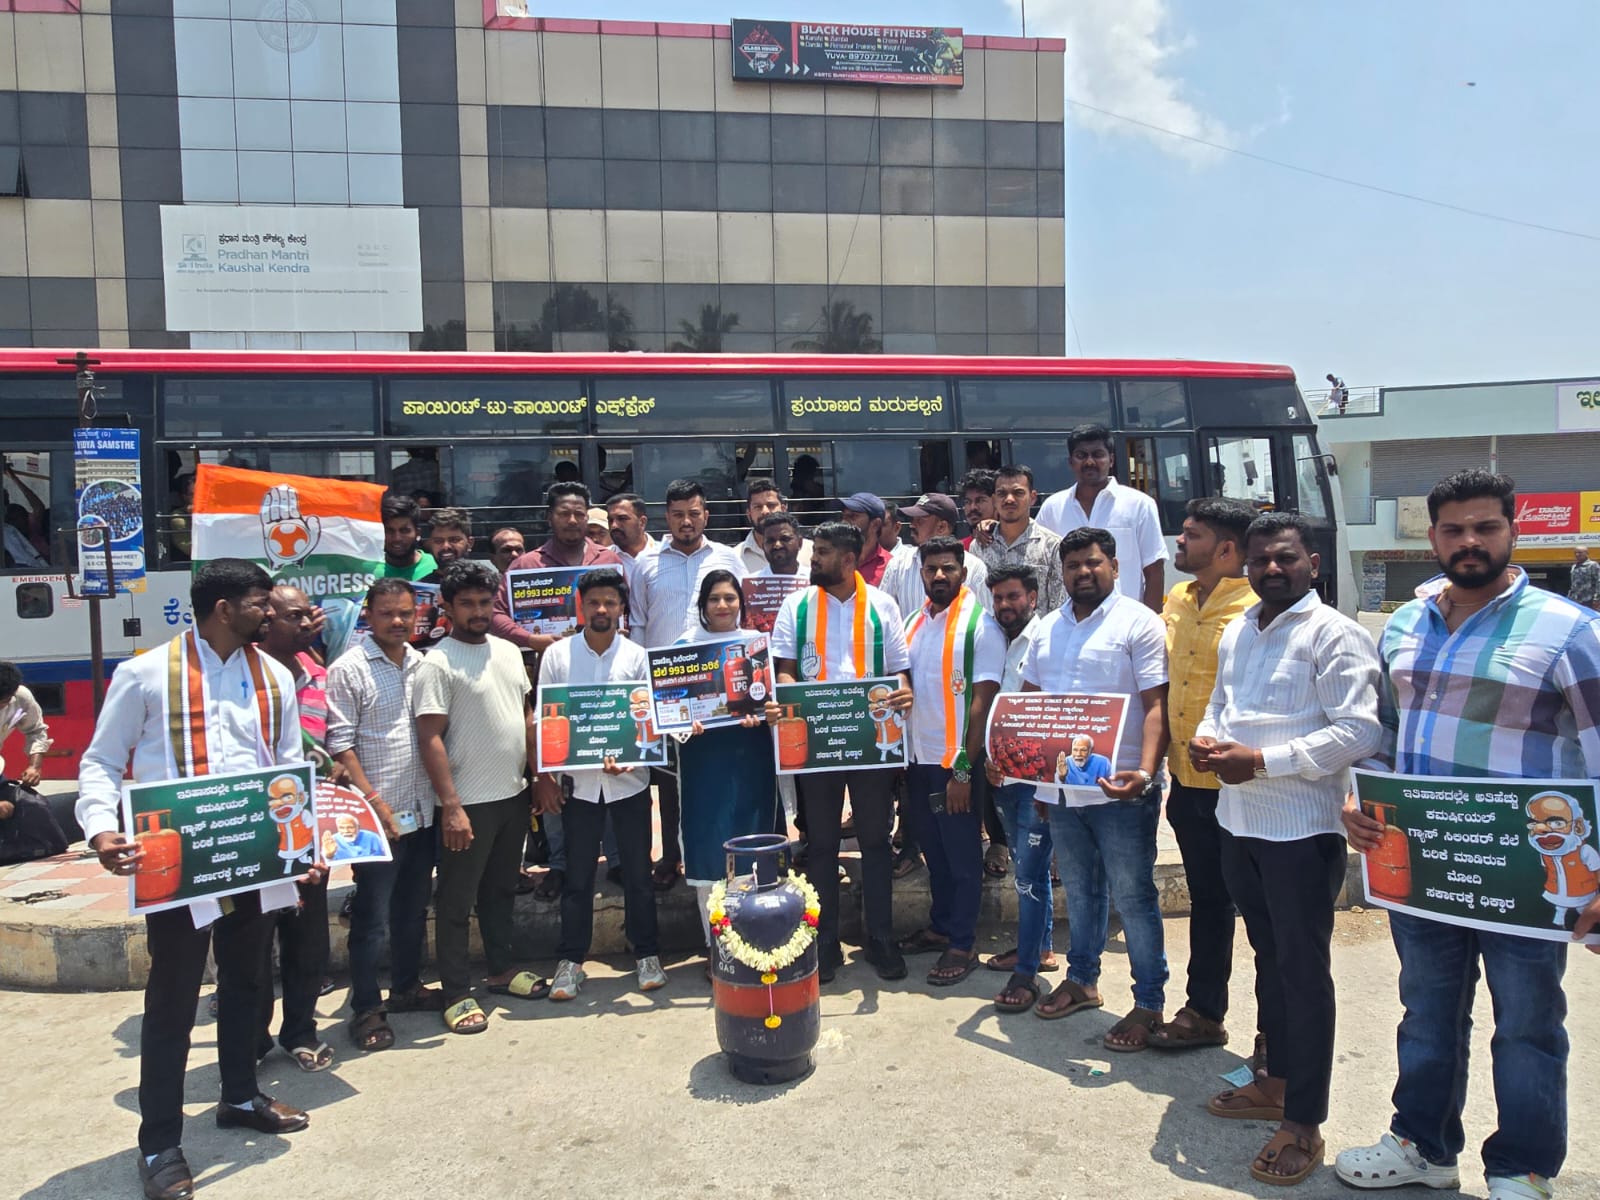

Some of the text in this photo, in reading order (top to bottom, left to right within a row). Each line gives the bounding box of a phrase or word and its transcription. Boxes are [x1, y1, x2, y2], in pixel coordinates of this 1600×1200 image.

[802, 26, 926, 38] BLACK HOUSE FITNESS
[218, 234, 307, 248] ಪ್ರಧಾನ ಮಂತ್ರಿ ಕೌಶಲ್ಯ ಕೇಂದ್ರ
[218, 249, 310, 260] Pradhan Mantri
[219, 263, 264, 273] Kaushal
[269, 263, 310, 273] Kendra
[791, 396, 943, 417] ಪ್ರಯಾಣದ ಮರುಕಲ್ಪನೆ
[76, 440, 135, 449] VIDYA SAMSTHE
[514, 586, 572, 599] ಬೆಲೆ 993 ದರ ಏರಿಕೆ
[653, 659, 720, 677] ಬೆಲೆ 993 ದರ ಏರಿಕೆ
[733, 681, 747, 692] LPG
[176, 779, 264, 799] ಇತಿಹಾಸದಲ್ಲೇ ಅತಿಹೆಚ್ಚು
[196, 798, 249, 814] ಕಮರ್ಷಿಯಲ್
[1403, 788, 1519, 809] ಇತಿಹಾಸದಲ್ಲೇ ಅತಿಹೆಚ್ಚು
[1426, 809, 1496, 823] ಕಮರ್ಷಿಯಲ್
[181, 821, 206, 837] ಗ್ಯಾಸ್
[250, 812, 264, 823] ಬೆಲೆ
[192, 830, 256, 849] ಏರಿಕೆ ಮಾಡಿರುವ
[1408, 827, 1438, 843] ಗ್ಯಾಸ್
[1499, 834, 1519, 847] ಬೆಲೆ
[211, 851, 238, 863] ಮೋದಿ
[1422, 848, 1506, 866] ಏರಿಕೆ ಮಾಡಿರುವ
[193, 862, 260, 884] ಸರ್ಕಾರಕ್ಕೆ ಧಿಕ್ಕಾರ
[1447, 870, 1482, 885] ಮೋದಿ
[1426, 887, 1515, 912] ಸರ್ಕಾರಕ್ಕೆ ಧಿಕ್ಕಾರ
[719, 962, 735, 974] GAS
